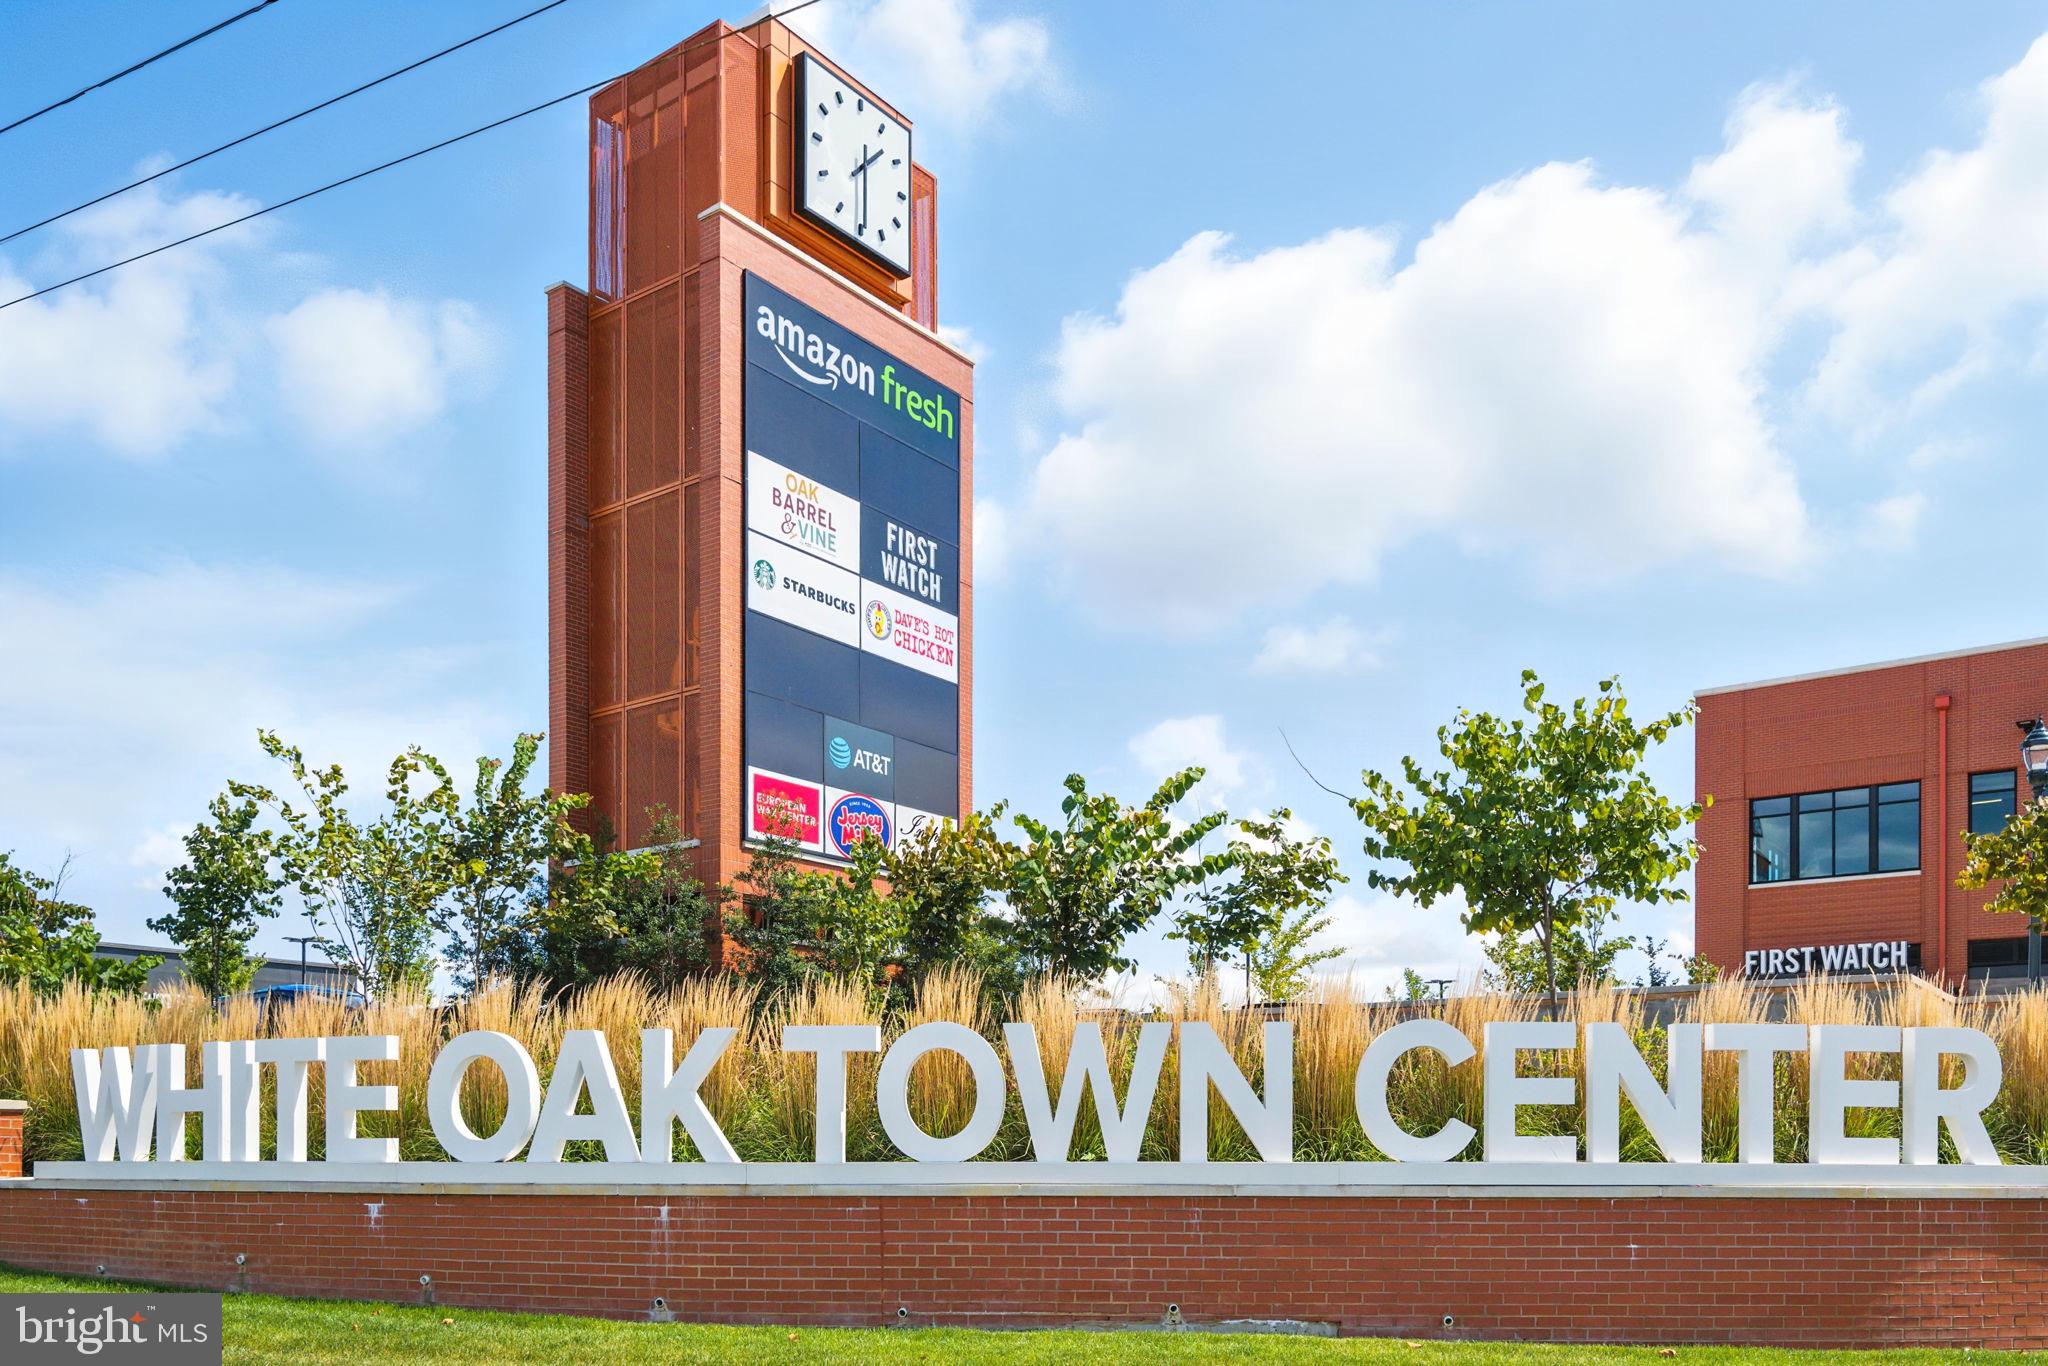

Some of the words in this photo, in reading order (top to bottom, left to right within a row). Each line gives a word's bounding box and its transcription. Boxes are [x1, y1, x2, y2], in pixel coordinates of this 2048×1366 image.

[757, 305, 875, 396] amazon
[881, 365, 953, 439] fresh
[785, 473, 819, 504] OAK
[772, 487, 837, 532] BARREL
[781, 512, 796, 535] &
[798, 519, 837, 552] VINE
[887, 521, 938, 570] FIRST
[783, 576, 856, 615] STARBUCKS
[881, 550, 941, 603] WATCH
[894, 609, 930, 636] DAVE'S
[934, 625, 954, 645] HOT
[894, 629, 954, 667] CHICKEN
[853, 748, 891, 776] AT&T
[837, 806, 884, 834] Jersey
[1745, 946, 1815, 976] FIRST
[1820, 940, 1908, 971] WATCH
[71, 1035, 400, 1163] WHITE
[428, 1030, 742, 1163] OAK
[783, 1021, 1293, 1163] TOWN
[1355, 1019, 2003, 1166] CENTER
